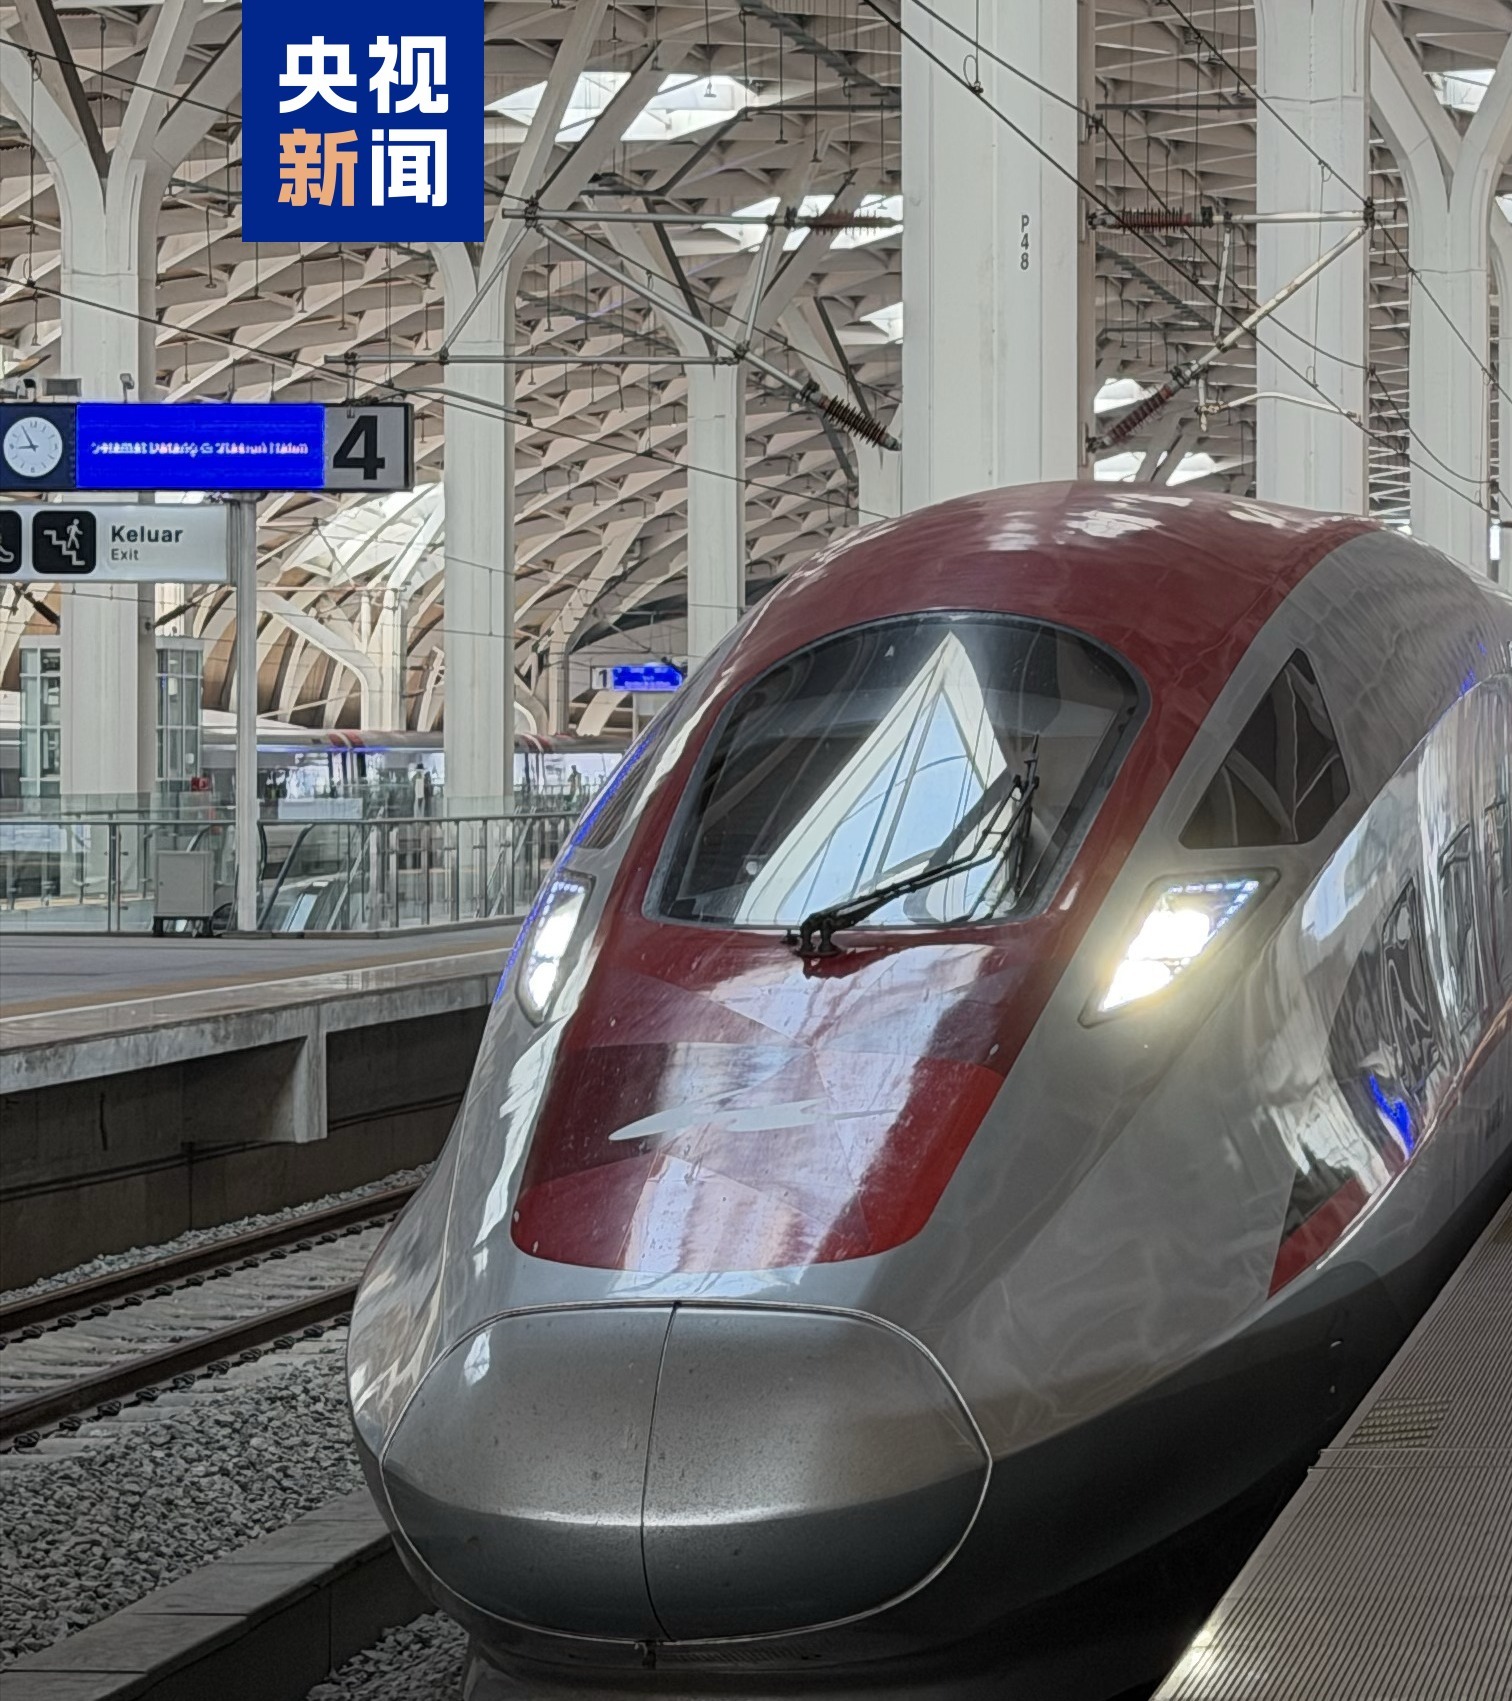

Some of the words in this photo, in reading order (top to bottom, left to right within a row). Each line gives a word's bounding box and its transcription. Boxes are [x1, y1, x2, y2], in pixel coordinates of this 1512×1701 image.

[1020, 214, 1030, 271] P48
[332, 414, 386, 481] 4
[111, 525, 184, 543] Keluar
[111, 548, 139, 561] Exit
